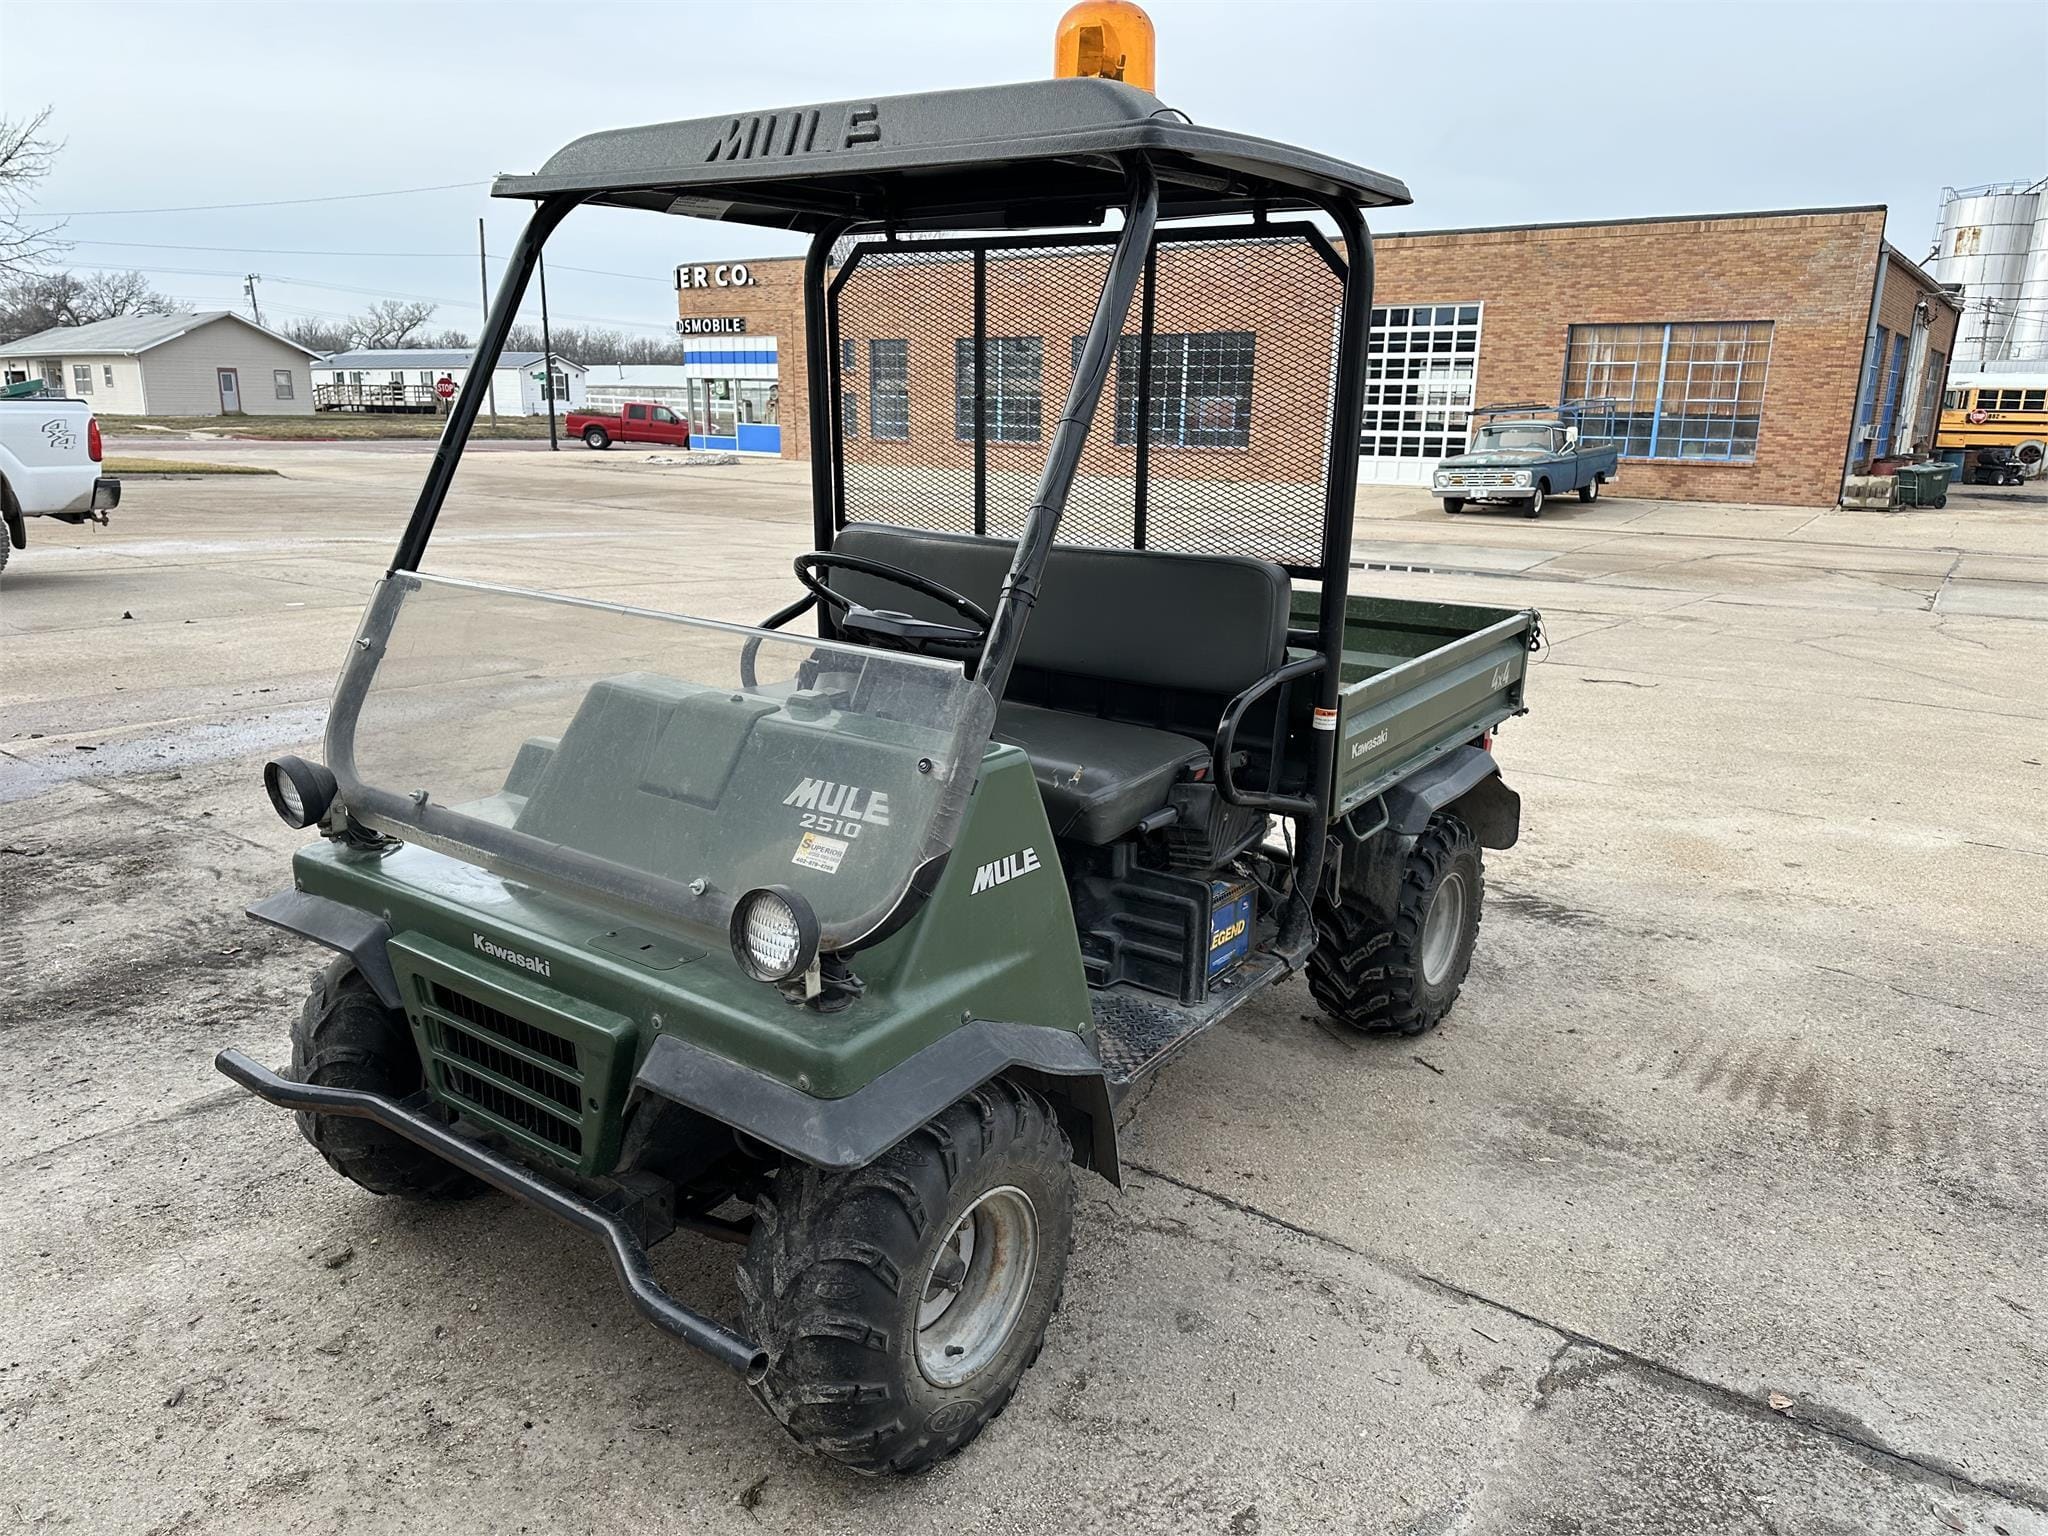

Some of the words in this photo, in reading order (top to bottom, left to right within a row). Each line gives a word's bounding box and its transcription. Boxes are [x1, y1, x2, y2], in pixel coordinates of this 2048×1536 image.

[704, 103, 881, 162] MULE
[673, 266, 708, 289] ER
[715, 264, 754, 287] CO.
[677, 317, 741, 333] DSMOBILE
[437, 383, 454, 393] STOP
[1351, 728, 1388, 759] Kawasaki
[782, 777, 889, 826] MULE
[800, 813, 862, 838] 2510
[970, 847, 1041, 896] MULE
[473, 932, 551, 977] Kawasaki
